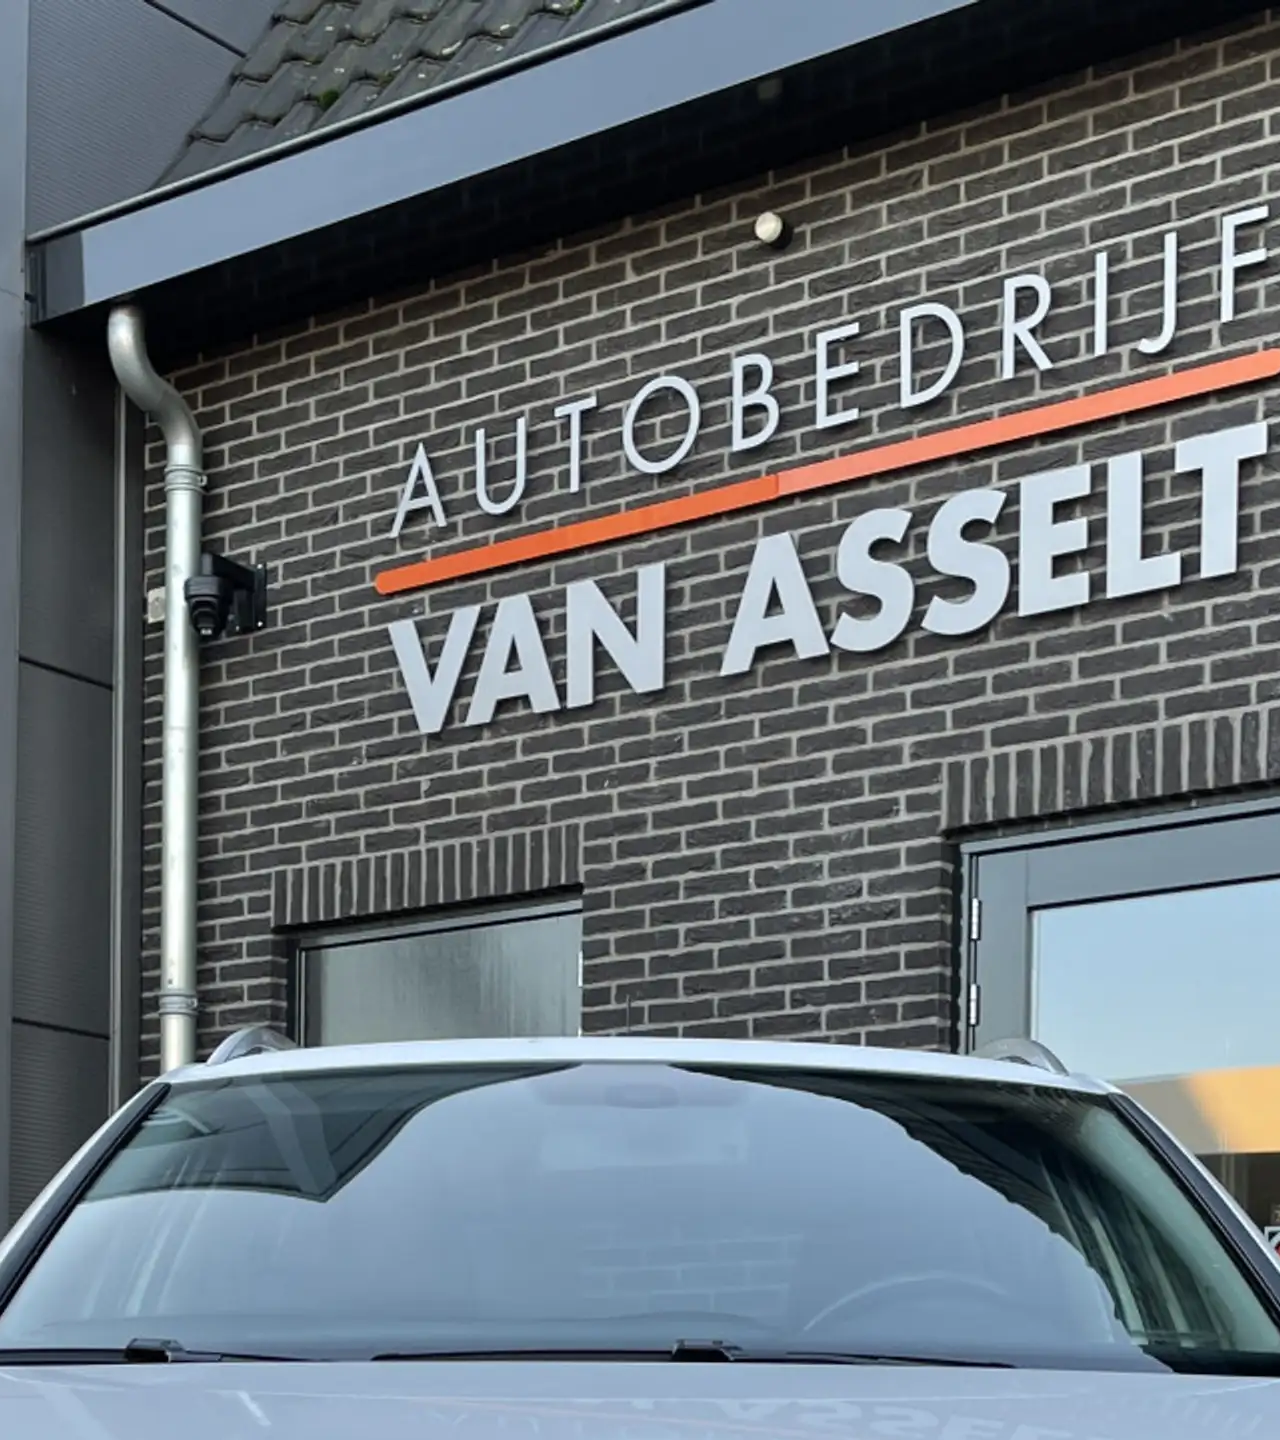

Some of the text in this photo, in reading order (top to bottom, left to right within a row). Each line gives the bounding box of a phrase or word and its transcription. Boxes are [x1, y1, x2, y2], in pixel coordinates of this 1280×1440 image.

[389, 204, 1271, 538] AUTOBEDRIJF
[386, 421, 1270, 735] VAN ASSELT
